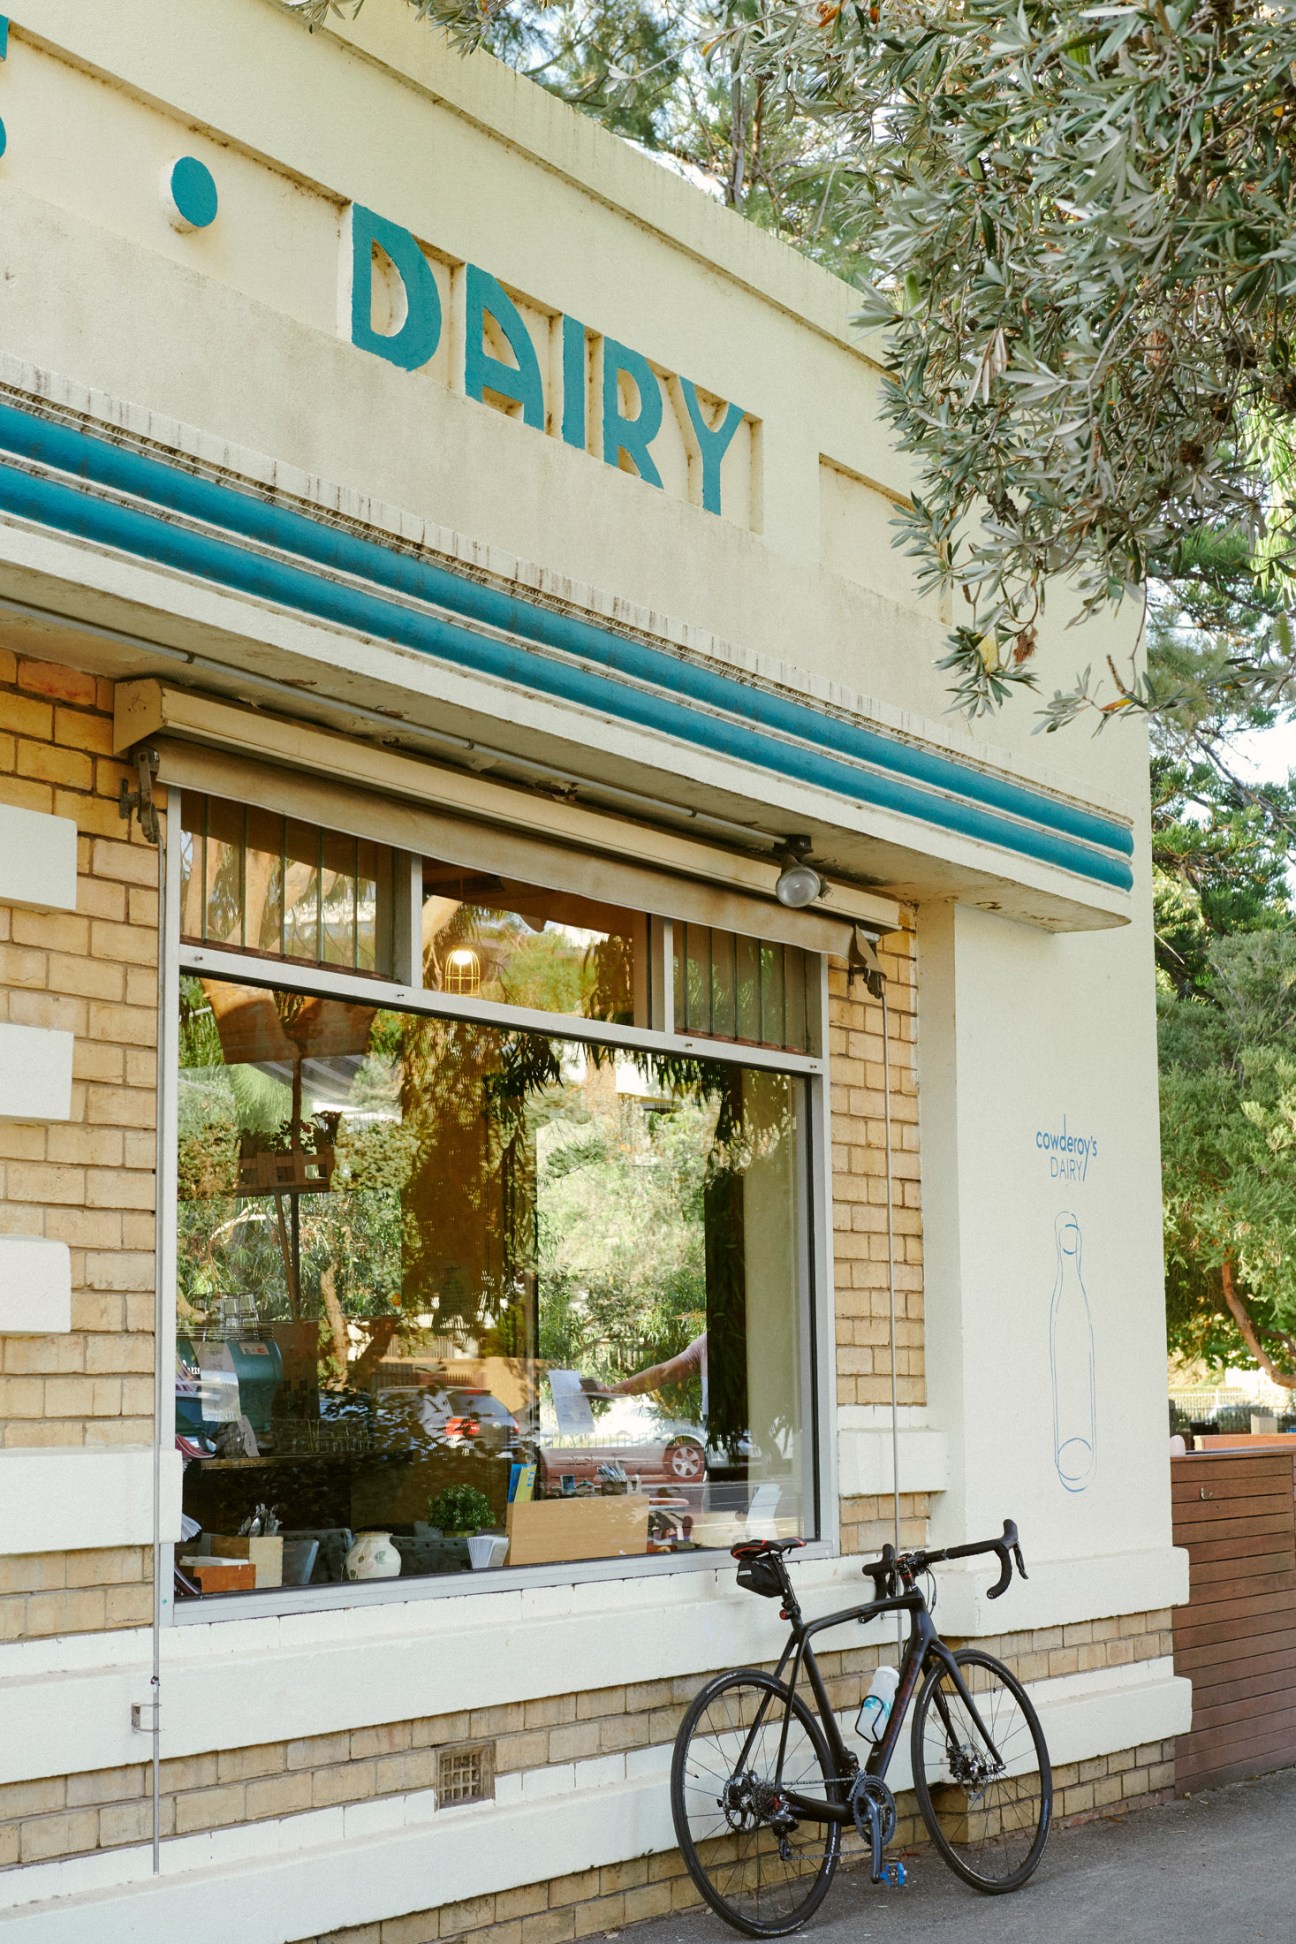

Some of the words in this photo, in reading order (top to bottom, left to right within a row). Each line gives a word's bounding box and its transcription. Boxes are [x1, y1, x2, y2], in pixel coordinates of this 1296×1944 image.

[351, 201, 745, 516] DAIRY
[1036, 1113, 1098, 1181] cowderoy's
[1050, 1156, 1083, 1181] DAIRY
